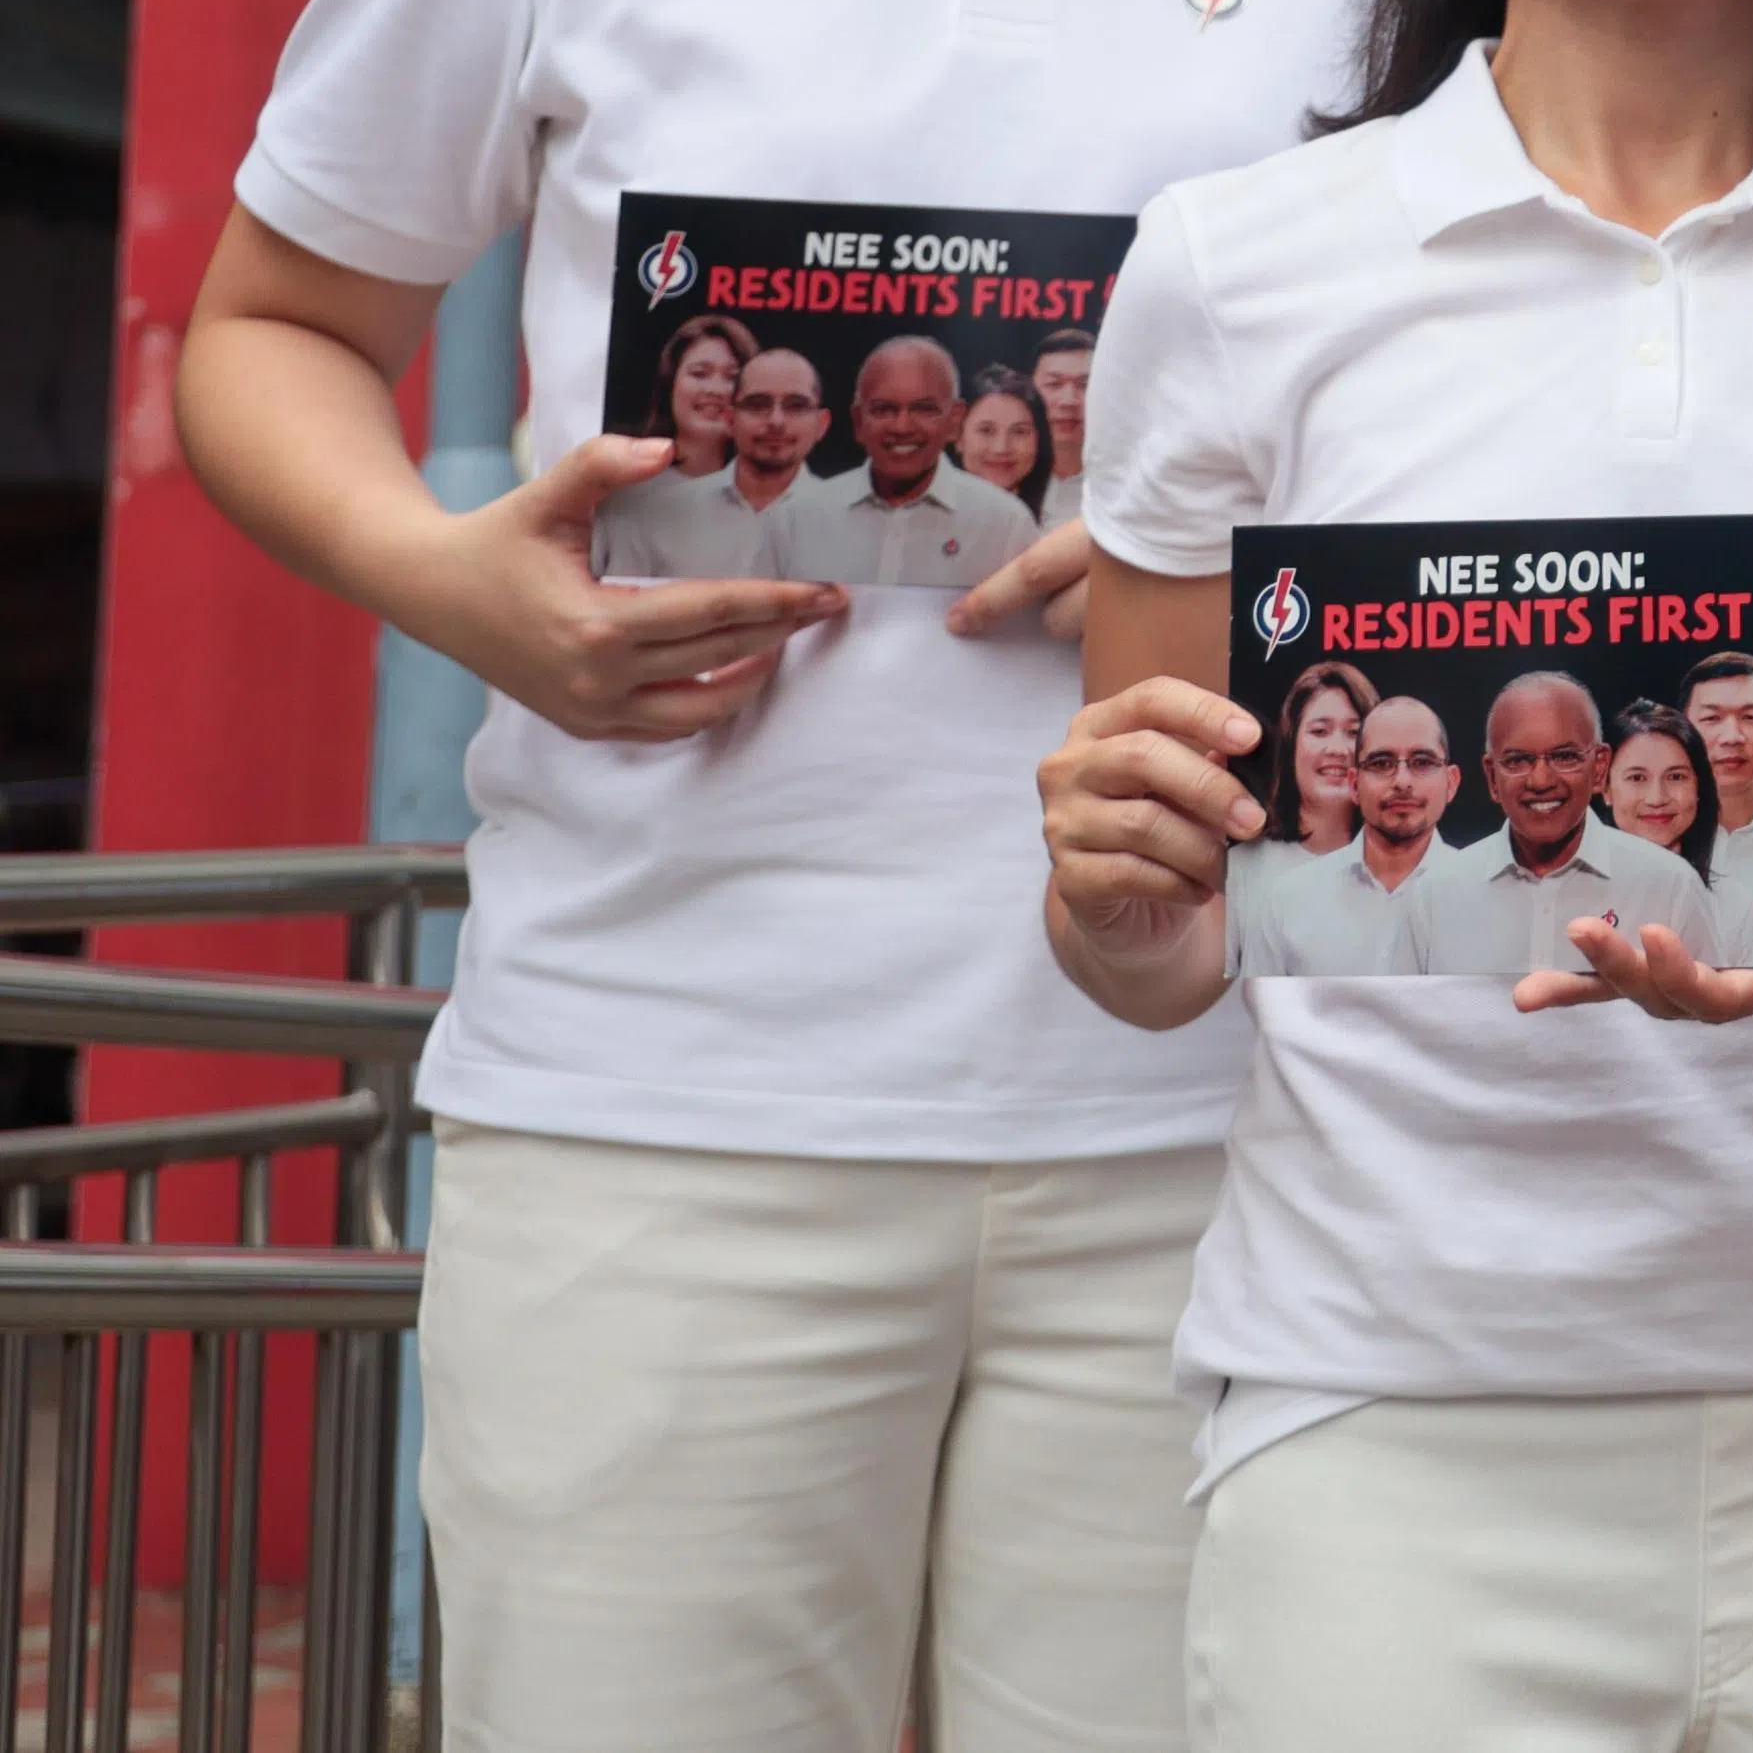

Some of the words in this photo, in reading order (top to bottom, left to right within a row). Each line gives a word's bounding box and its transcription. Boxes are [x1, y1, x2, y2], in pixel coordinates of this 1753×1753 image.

[804, 231, 883, 268] NEE
[891, 234, 1010, 274] SOON:
[707, 265, 960, 317] RESIDENTS
[1418, 554, 1500, 596] NEE
[1512, 550, 1646, 594] SOON:
[1322, 595, 1594, 652] RESIDENTS
